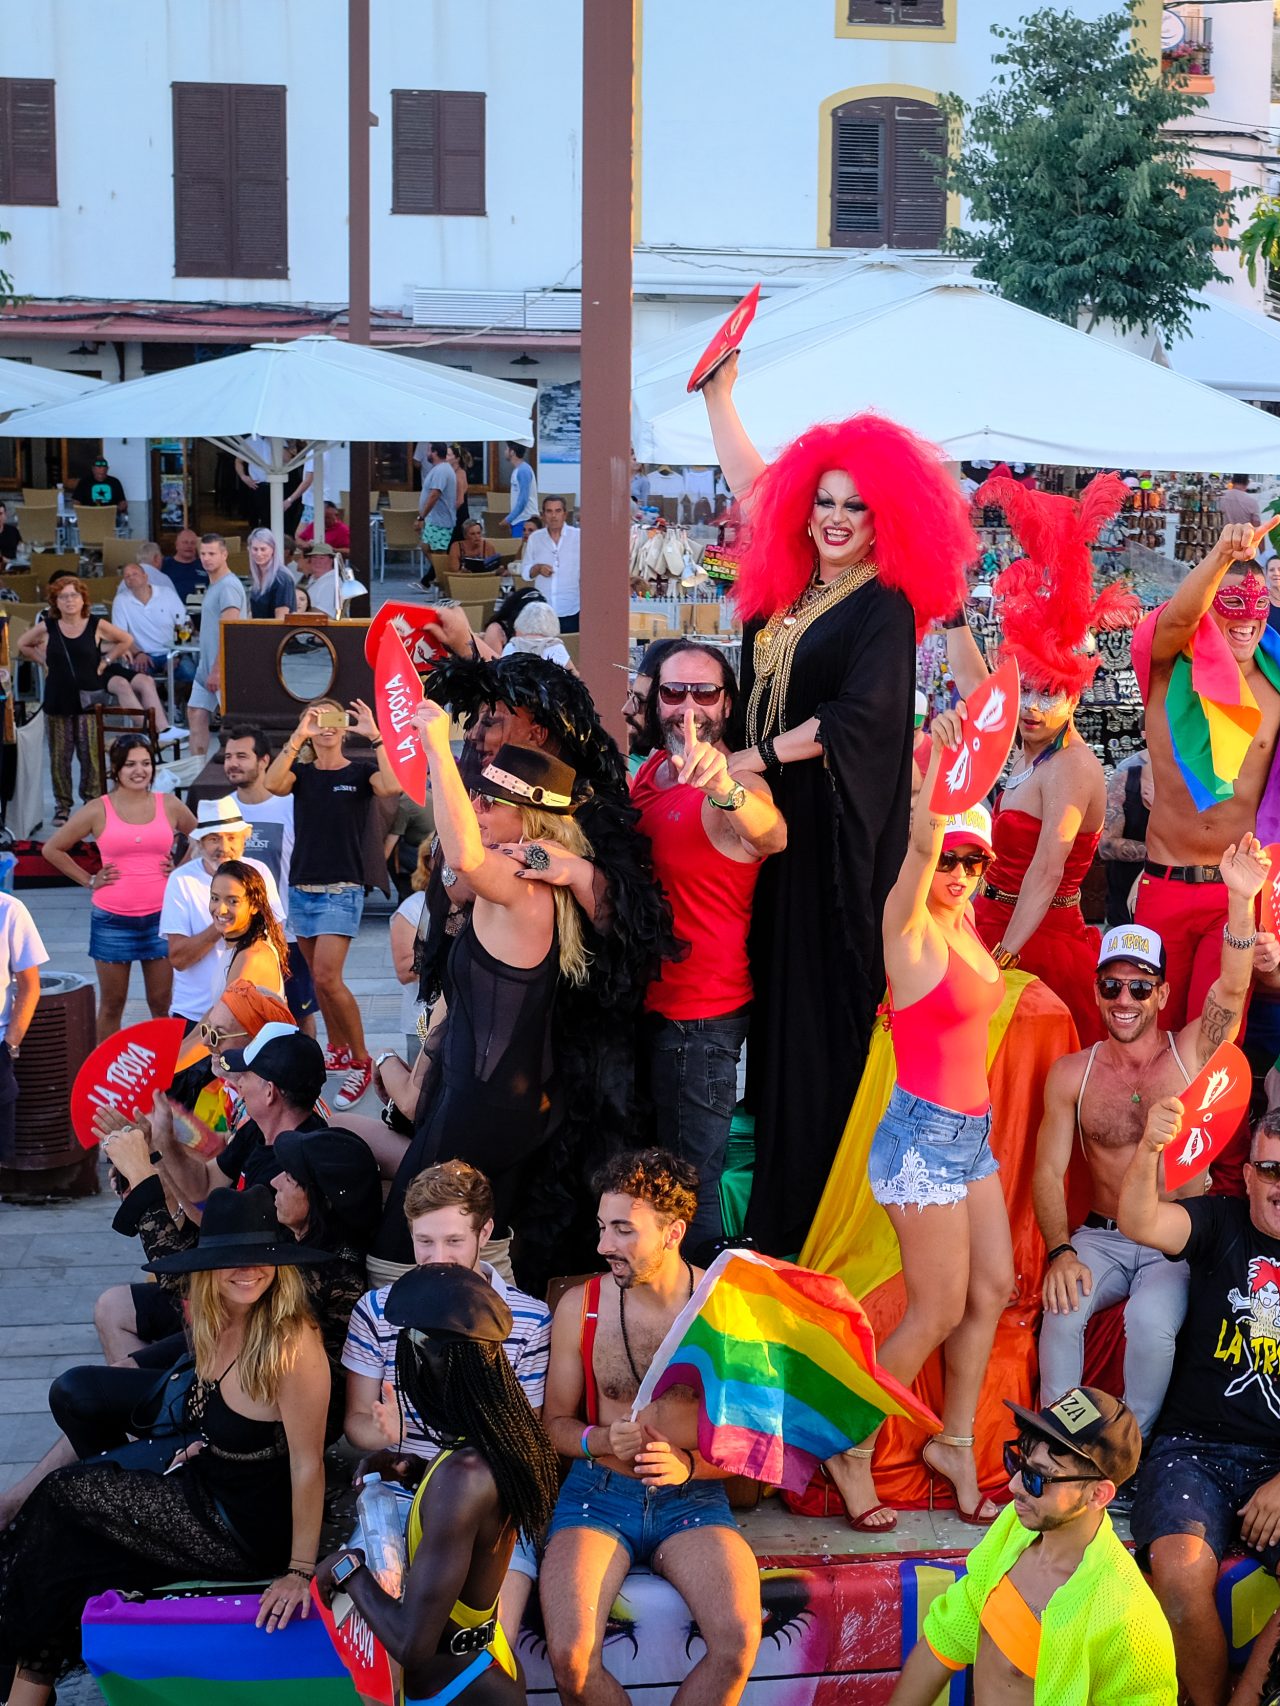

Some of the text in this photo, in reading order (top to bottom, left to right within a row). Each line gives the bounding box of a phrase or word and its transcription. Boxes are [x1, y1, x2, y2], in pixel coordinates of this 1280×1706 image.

[385, 673, 417, 763] LA TROYA
[1107, 933, 1150, 954] LA TROYA
[106, 1042, 156, 1090] TROYA
[1213, 1318, 1243, 1365] LA
